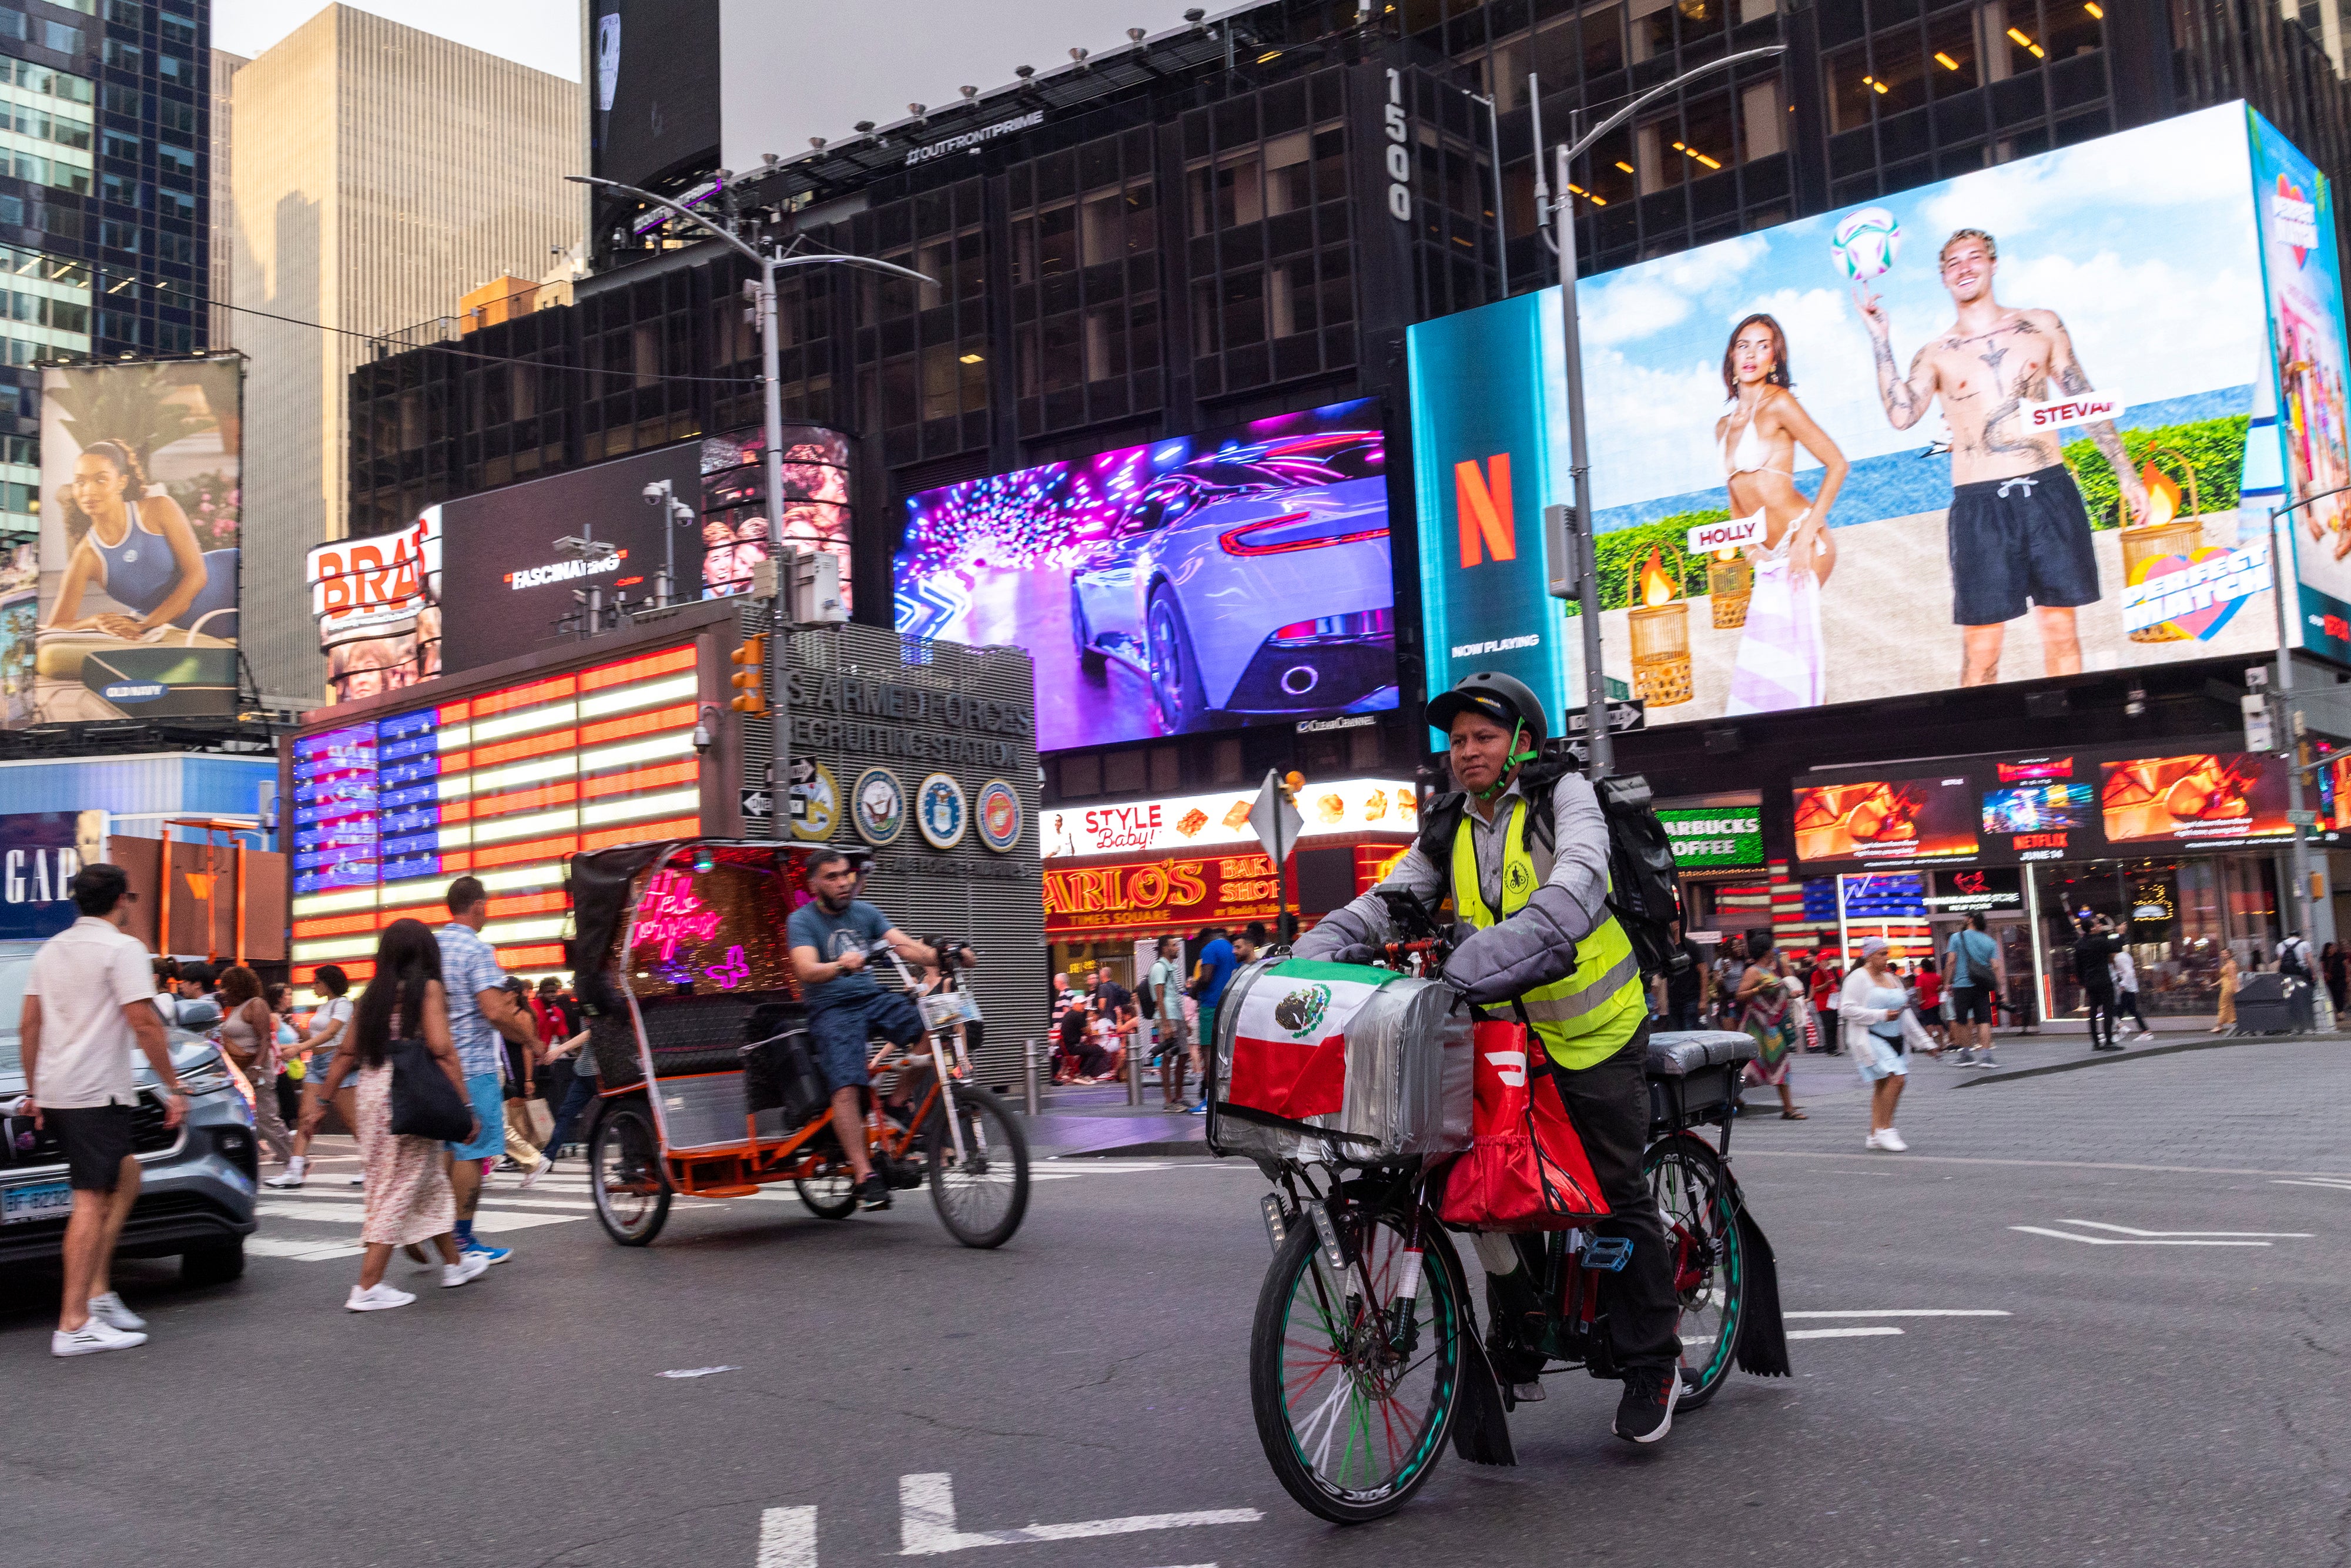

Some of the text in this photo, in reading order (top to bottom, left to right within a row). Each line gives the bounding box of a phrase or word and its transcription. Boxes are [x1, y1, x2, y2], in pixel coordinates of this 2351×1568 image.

[1385, 68, 1411, 222] 1500
[1699, 522, 1757, 547] HOLLY
[2119, 542, 2271, 609] PERFECT
[2122, 564, 2274, 634] MATCH
[1451, 634, 1540, 658] NOW PLAYING
[106, 685, 163, 698] OLD NAVY
[791, 716, 925, 757] ECRUITING
[1086, 805, 1163, 834] STYLE
[1663, 818, 1759, 836] ARBUCKS
[1096, 826, 1155, 850] Baby!
[1670, 839, 1736, 856] OFFEE
[2012, 832, 2069, 850] NETFLIX
[5, 847, 78, 904] GAP
[1042, 858, 1207, 913] ARLO'S
[1069, 910, 1171, 926] TIMES SQUARE
